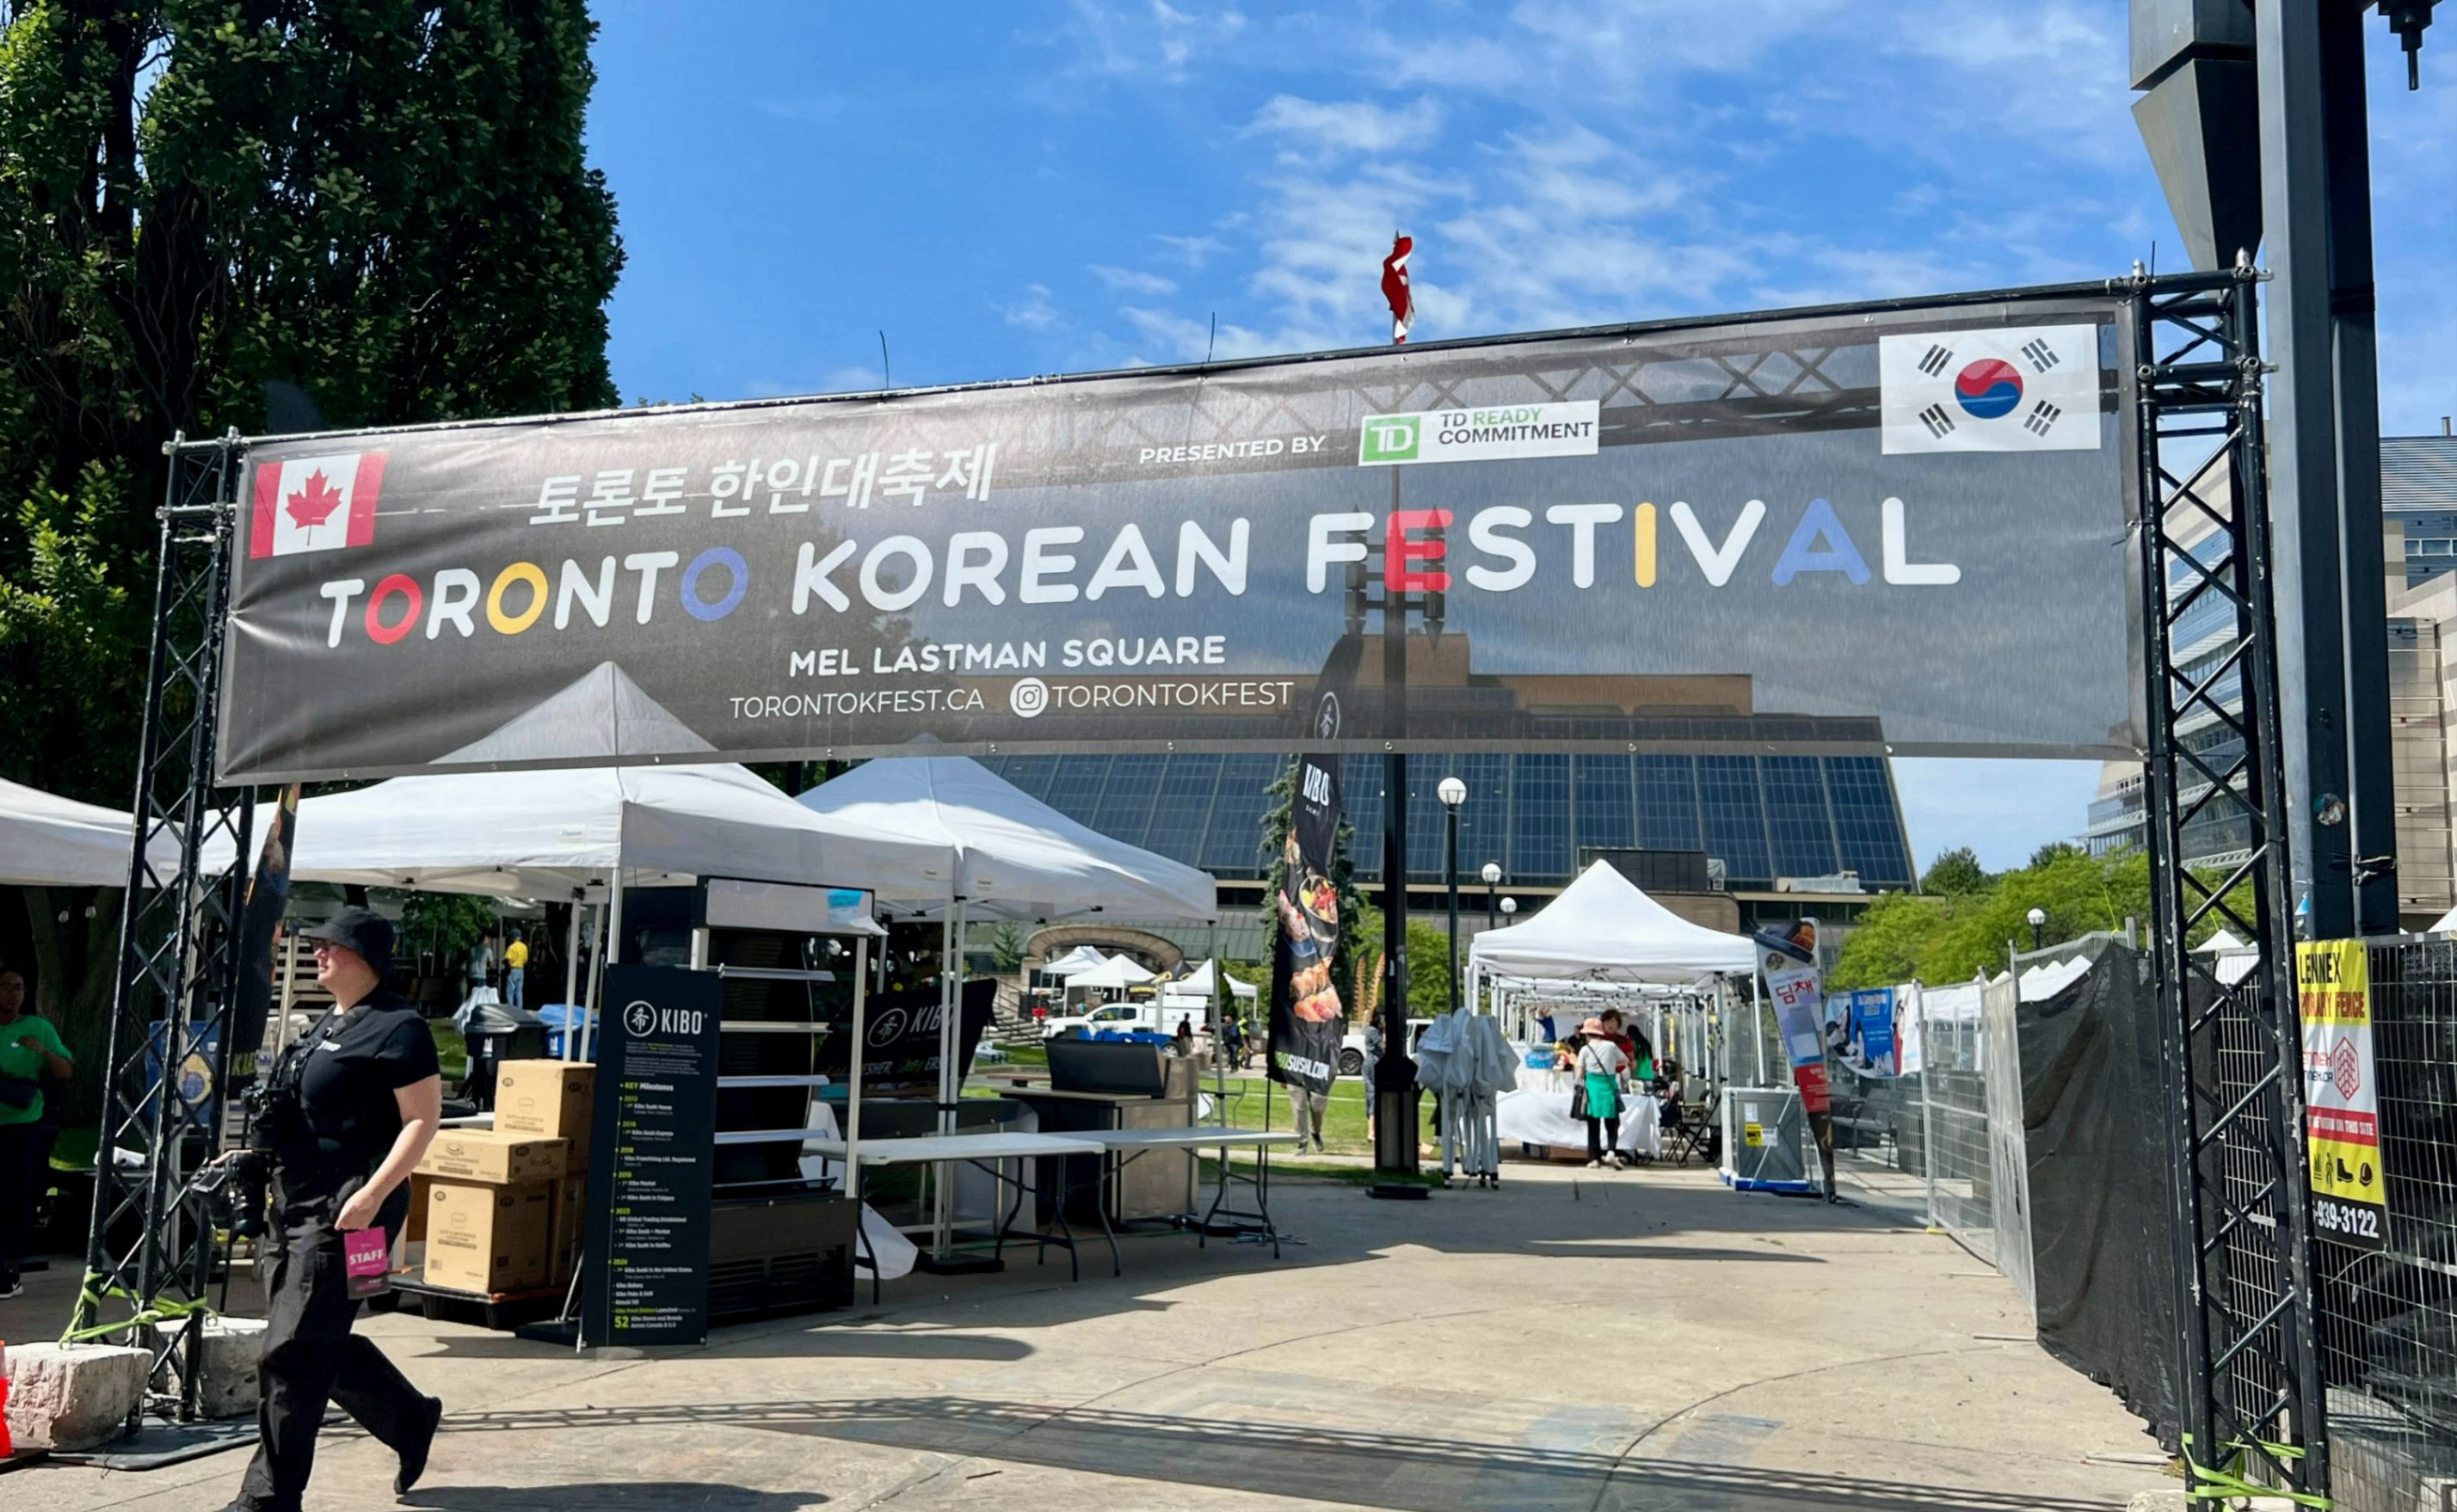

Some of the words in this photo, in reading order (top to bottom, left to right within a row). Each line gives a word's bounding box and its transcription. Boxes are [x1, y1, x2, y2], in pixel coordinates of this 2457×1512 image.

[1439, 413, 1468, 427] TD
[1472, 407, 1543, 426] READY
[1369, 421, 1414, 453] TD
[1438, 420, 1594, 446] COMMITMENT
[1139, 438, 1283, 464] PRESENTED
[1290, 435, 1327, 454] BY
[529, 466, 688, 528] 토론토
[709, 442, 999, 519] 한인대축제
[319, 546, 749, 648] TORONTO
[791, 517, 1250, 615] KOREAN
[1306, 496, 1961, 593] FESTIVAL
[789, 647, 859, 678] MEL
[872, 641, 1047, 674] LASTMAN
[1062, 635, 1227, 667] SQUARE
[730, 688, 985, 719] TORONTOKFEST.CA
[1051, 680, 1294, 708] TORONTOKFEST
[1776, 980, 1814, 1005] 딤채
[2335, 991, 2365, 1018] FENCE
[661, 1008, 703, 1036] KIBO
[349, 1249, 384, 1265] STAFF
[614, 1315, 630, 1329] 52
